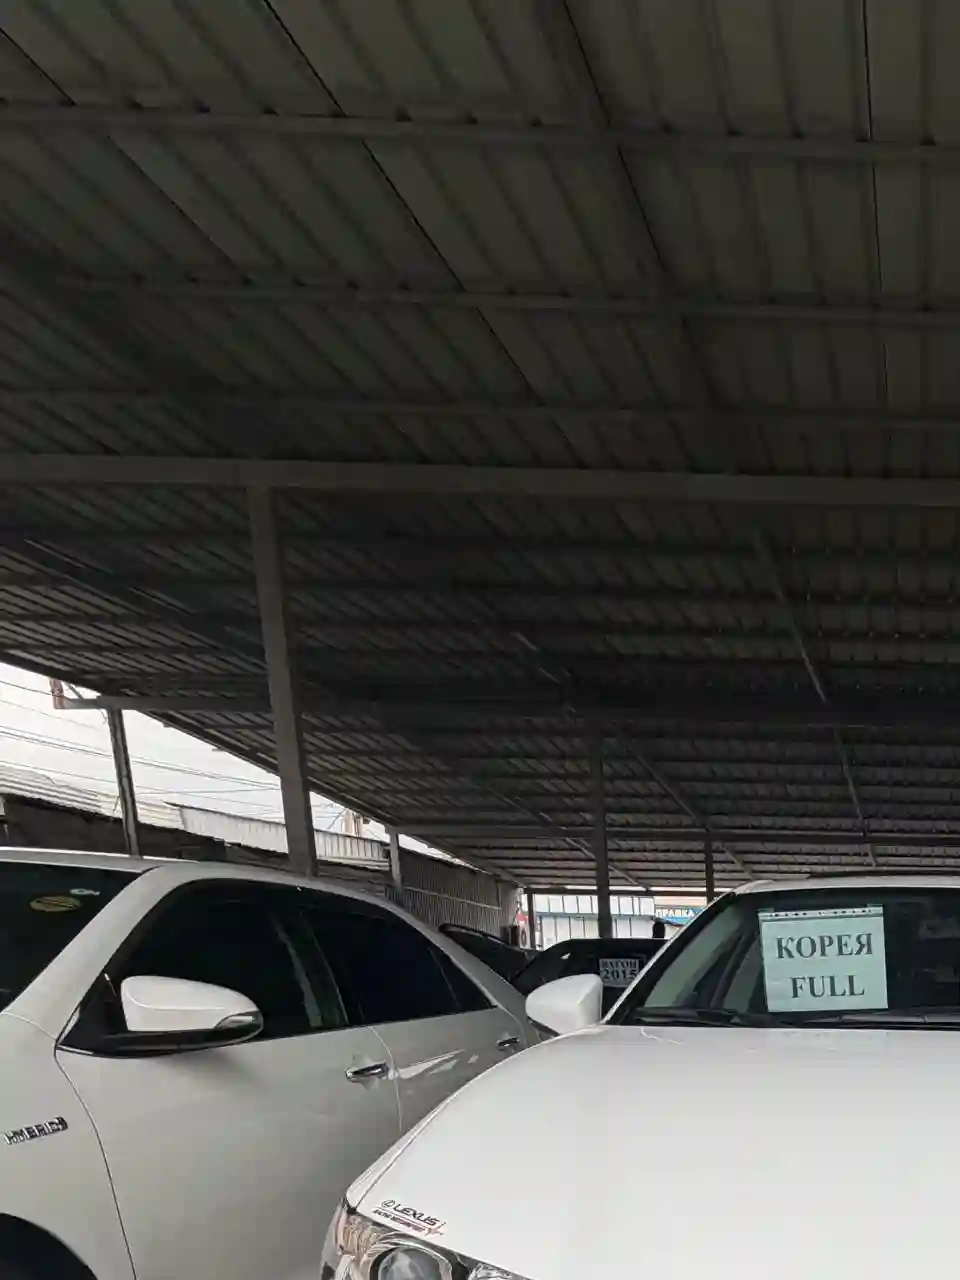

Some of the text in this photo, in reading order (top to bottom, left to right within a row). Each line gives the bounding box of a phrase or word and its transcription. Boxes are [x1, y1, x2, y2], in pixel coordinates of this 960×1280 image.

[776, 932, 873, 959] КОРЕЯ
[602, 968, 638, 980] 2015
[790, 974, 866, 999] FULL
[393, 1203, 441, 1227] LEXUS
